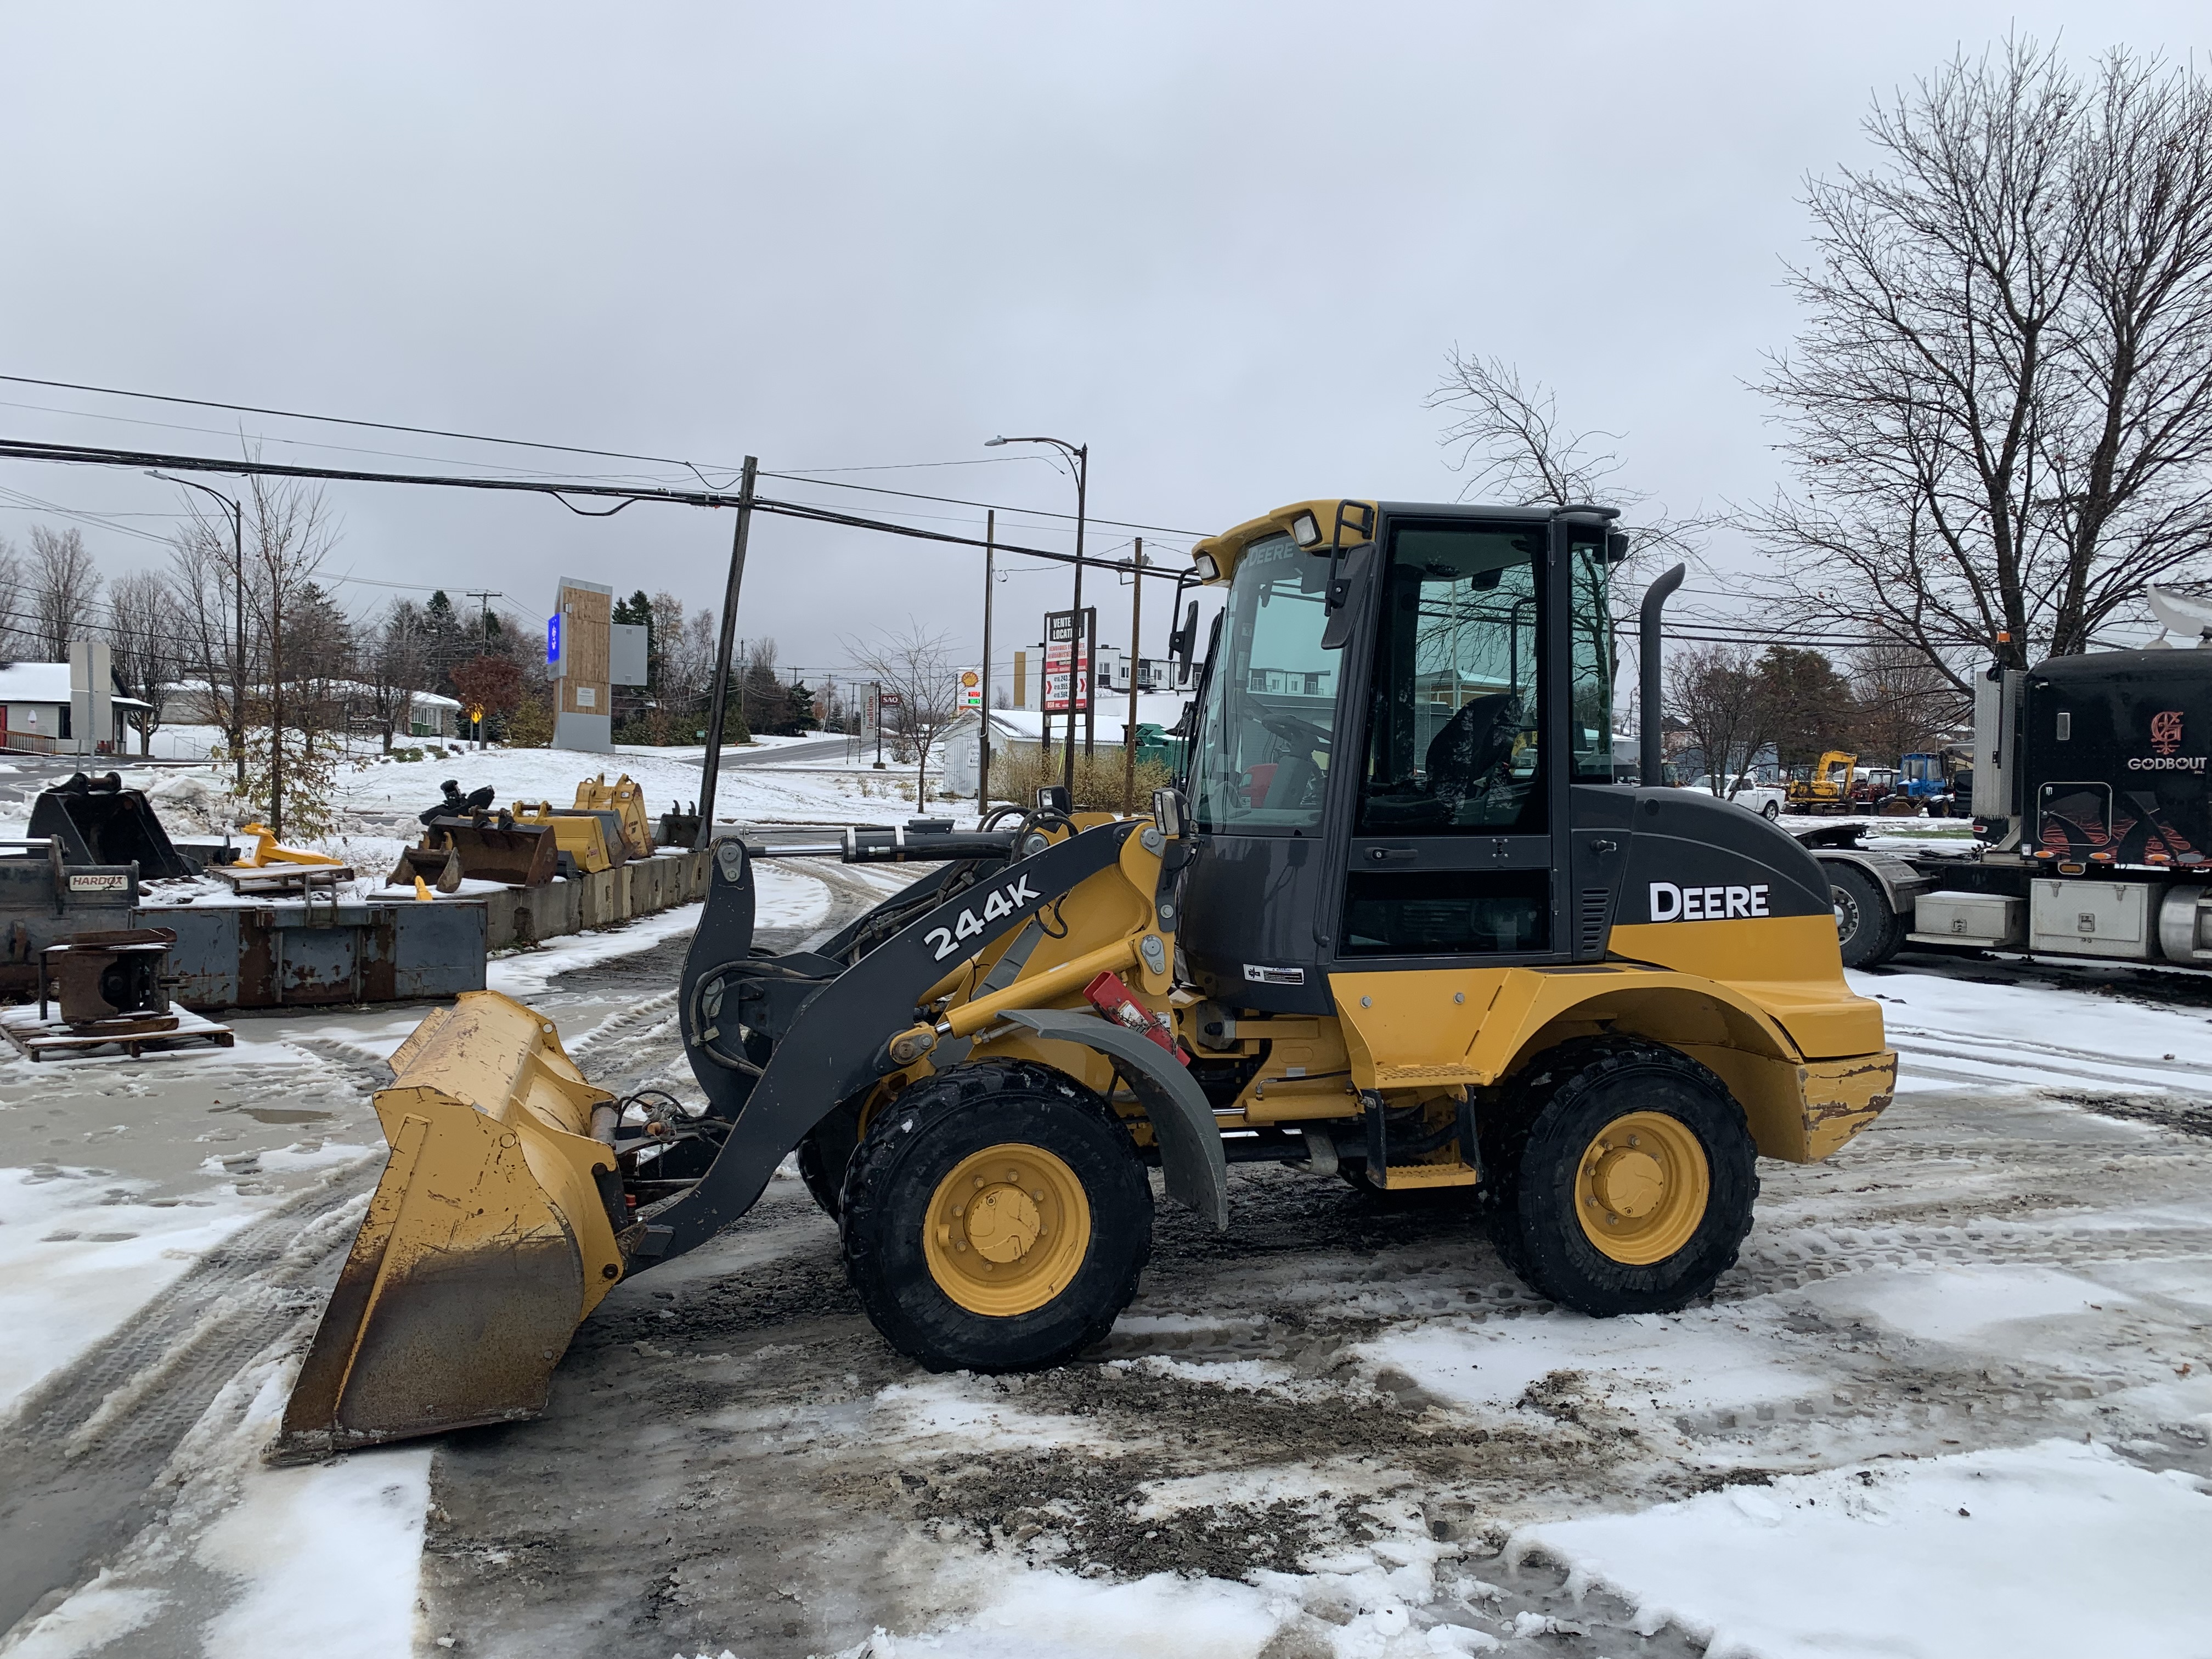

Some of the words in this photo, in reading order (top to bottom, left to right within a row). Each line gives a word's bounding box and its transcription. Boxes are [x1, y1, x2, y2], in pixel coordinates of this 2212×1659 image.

[1248, 542, 1296, 567] DEERE
[1053, 617, 1071, 628] VENTE
[1053, 627, 1081, 640] LOCATI
[2128, 758, 2208, 770] GODBOUT
[73, 876, 123, 885] HARDOX
[1649, 882, 1770, 922] DEERE
[923, 873, 1041, 961] 244K
